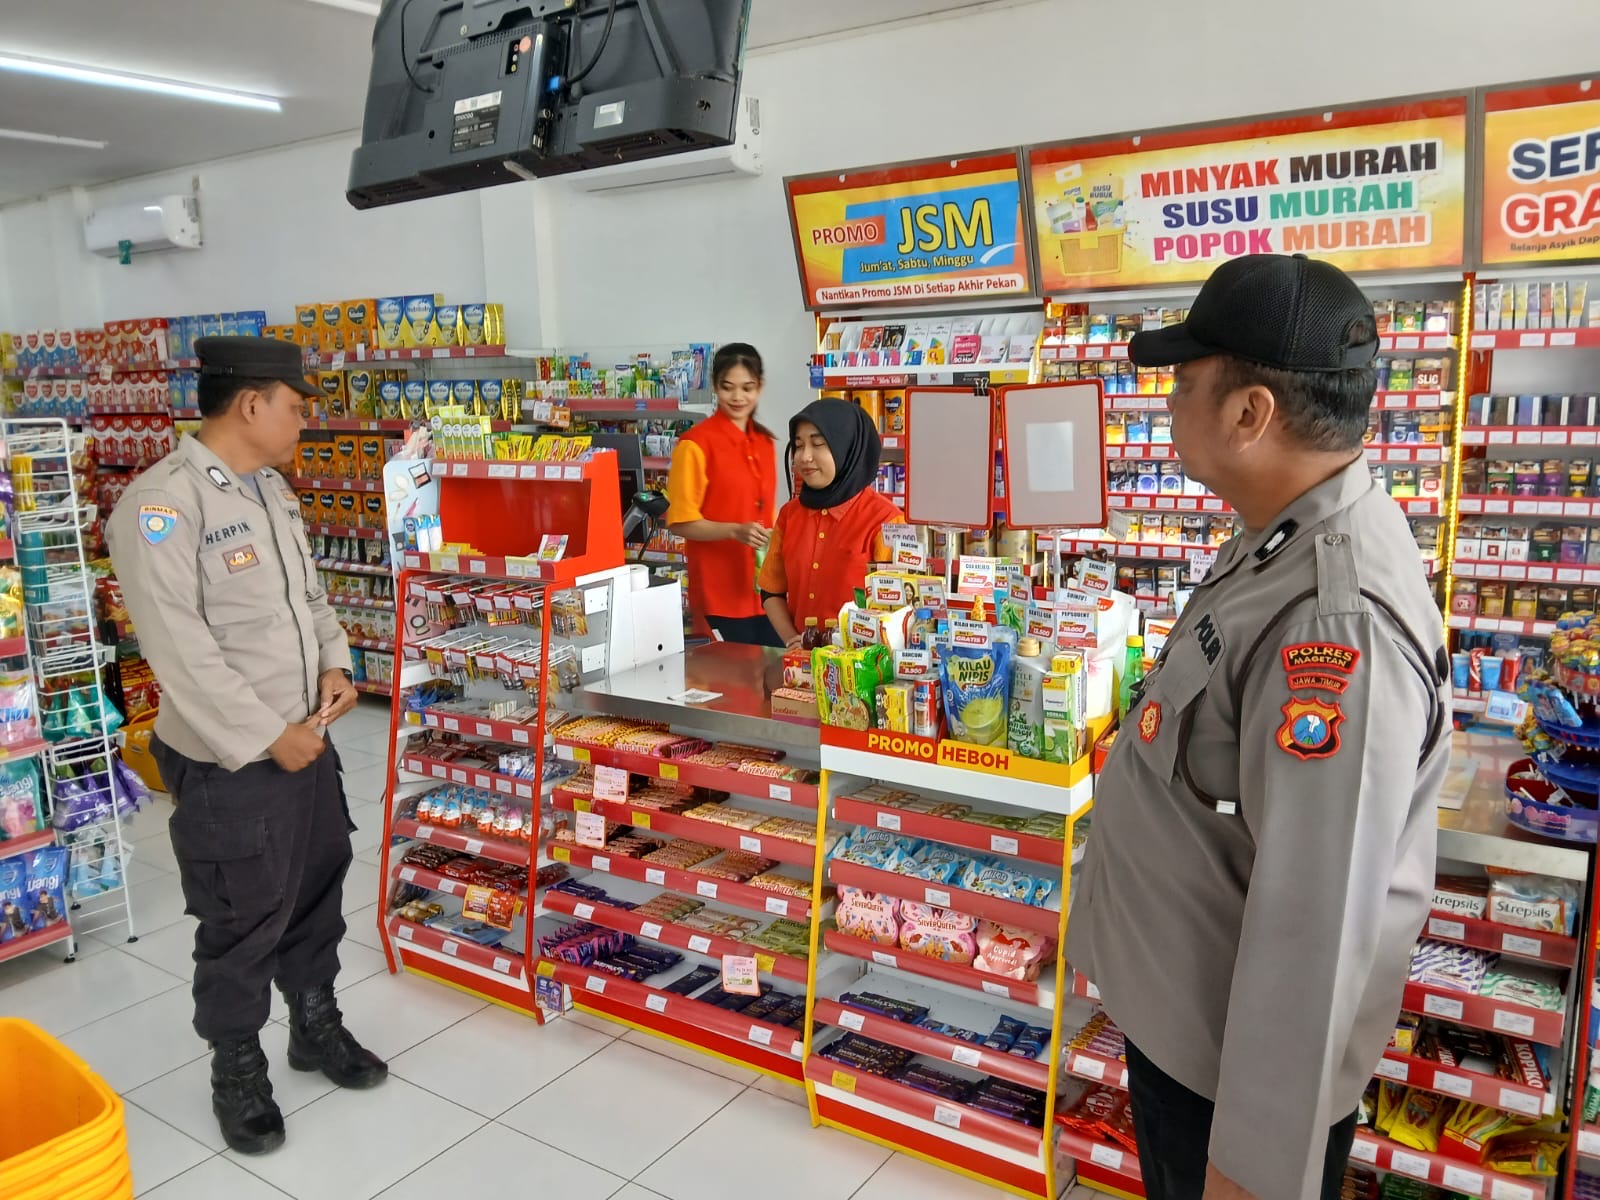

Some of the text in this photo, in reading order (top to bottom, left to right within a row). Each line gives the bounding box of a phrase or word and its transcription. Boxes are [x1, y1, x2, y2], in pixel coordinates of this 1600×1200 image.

[1141, 141, 1437, 198] MINYAK MURAH
[1163, 182, 1413, 228] SUSU MURAH
[812, 198, 994, 254] PROMO JSM
[1154, 215, 1426, 261] POPOK MURAH
[1511, 243, 1546, 252] Belanja
[1549, 239, 1576, 250] Asyik
[860, 254, 974, 273] Jum'at, Sabtu, Minggu
[822, 277, 1017, 300] Nantikan Promo JSM Di Setiap Akhir Pekan
[205, 521, 251, 545] HERPIN
[1194, 613, 1222, 666] POLRI
[1288, 647, 1353, 662] POLRES
[1294, 656, 1347, 667] MAGETAN
[958, 660, 991, 671] KILAU
[959, 671, 989, 682] NIPIS
[1294, 677, 1341, 689] JAWA TIMUR
[868, 734, 1009, 770] PROMO HEBOH
[851, 899, 884, 913] SILVERQUEEN
[1496, 901, 1551, 919] Strepsils
[918, 918, 957, 931] SILVERQUEEN
[993, 946, 1017, 959] Cupid
[1514, 1043, 1544, 1088] KOPIKO
